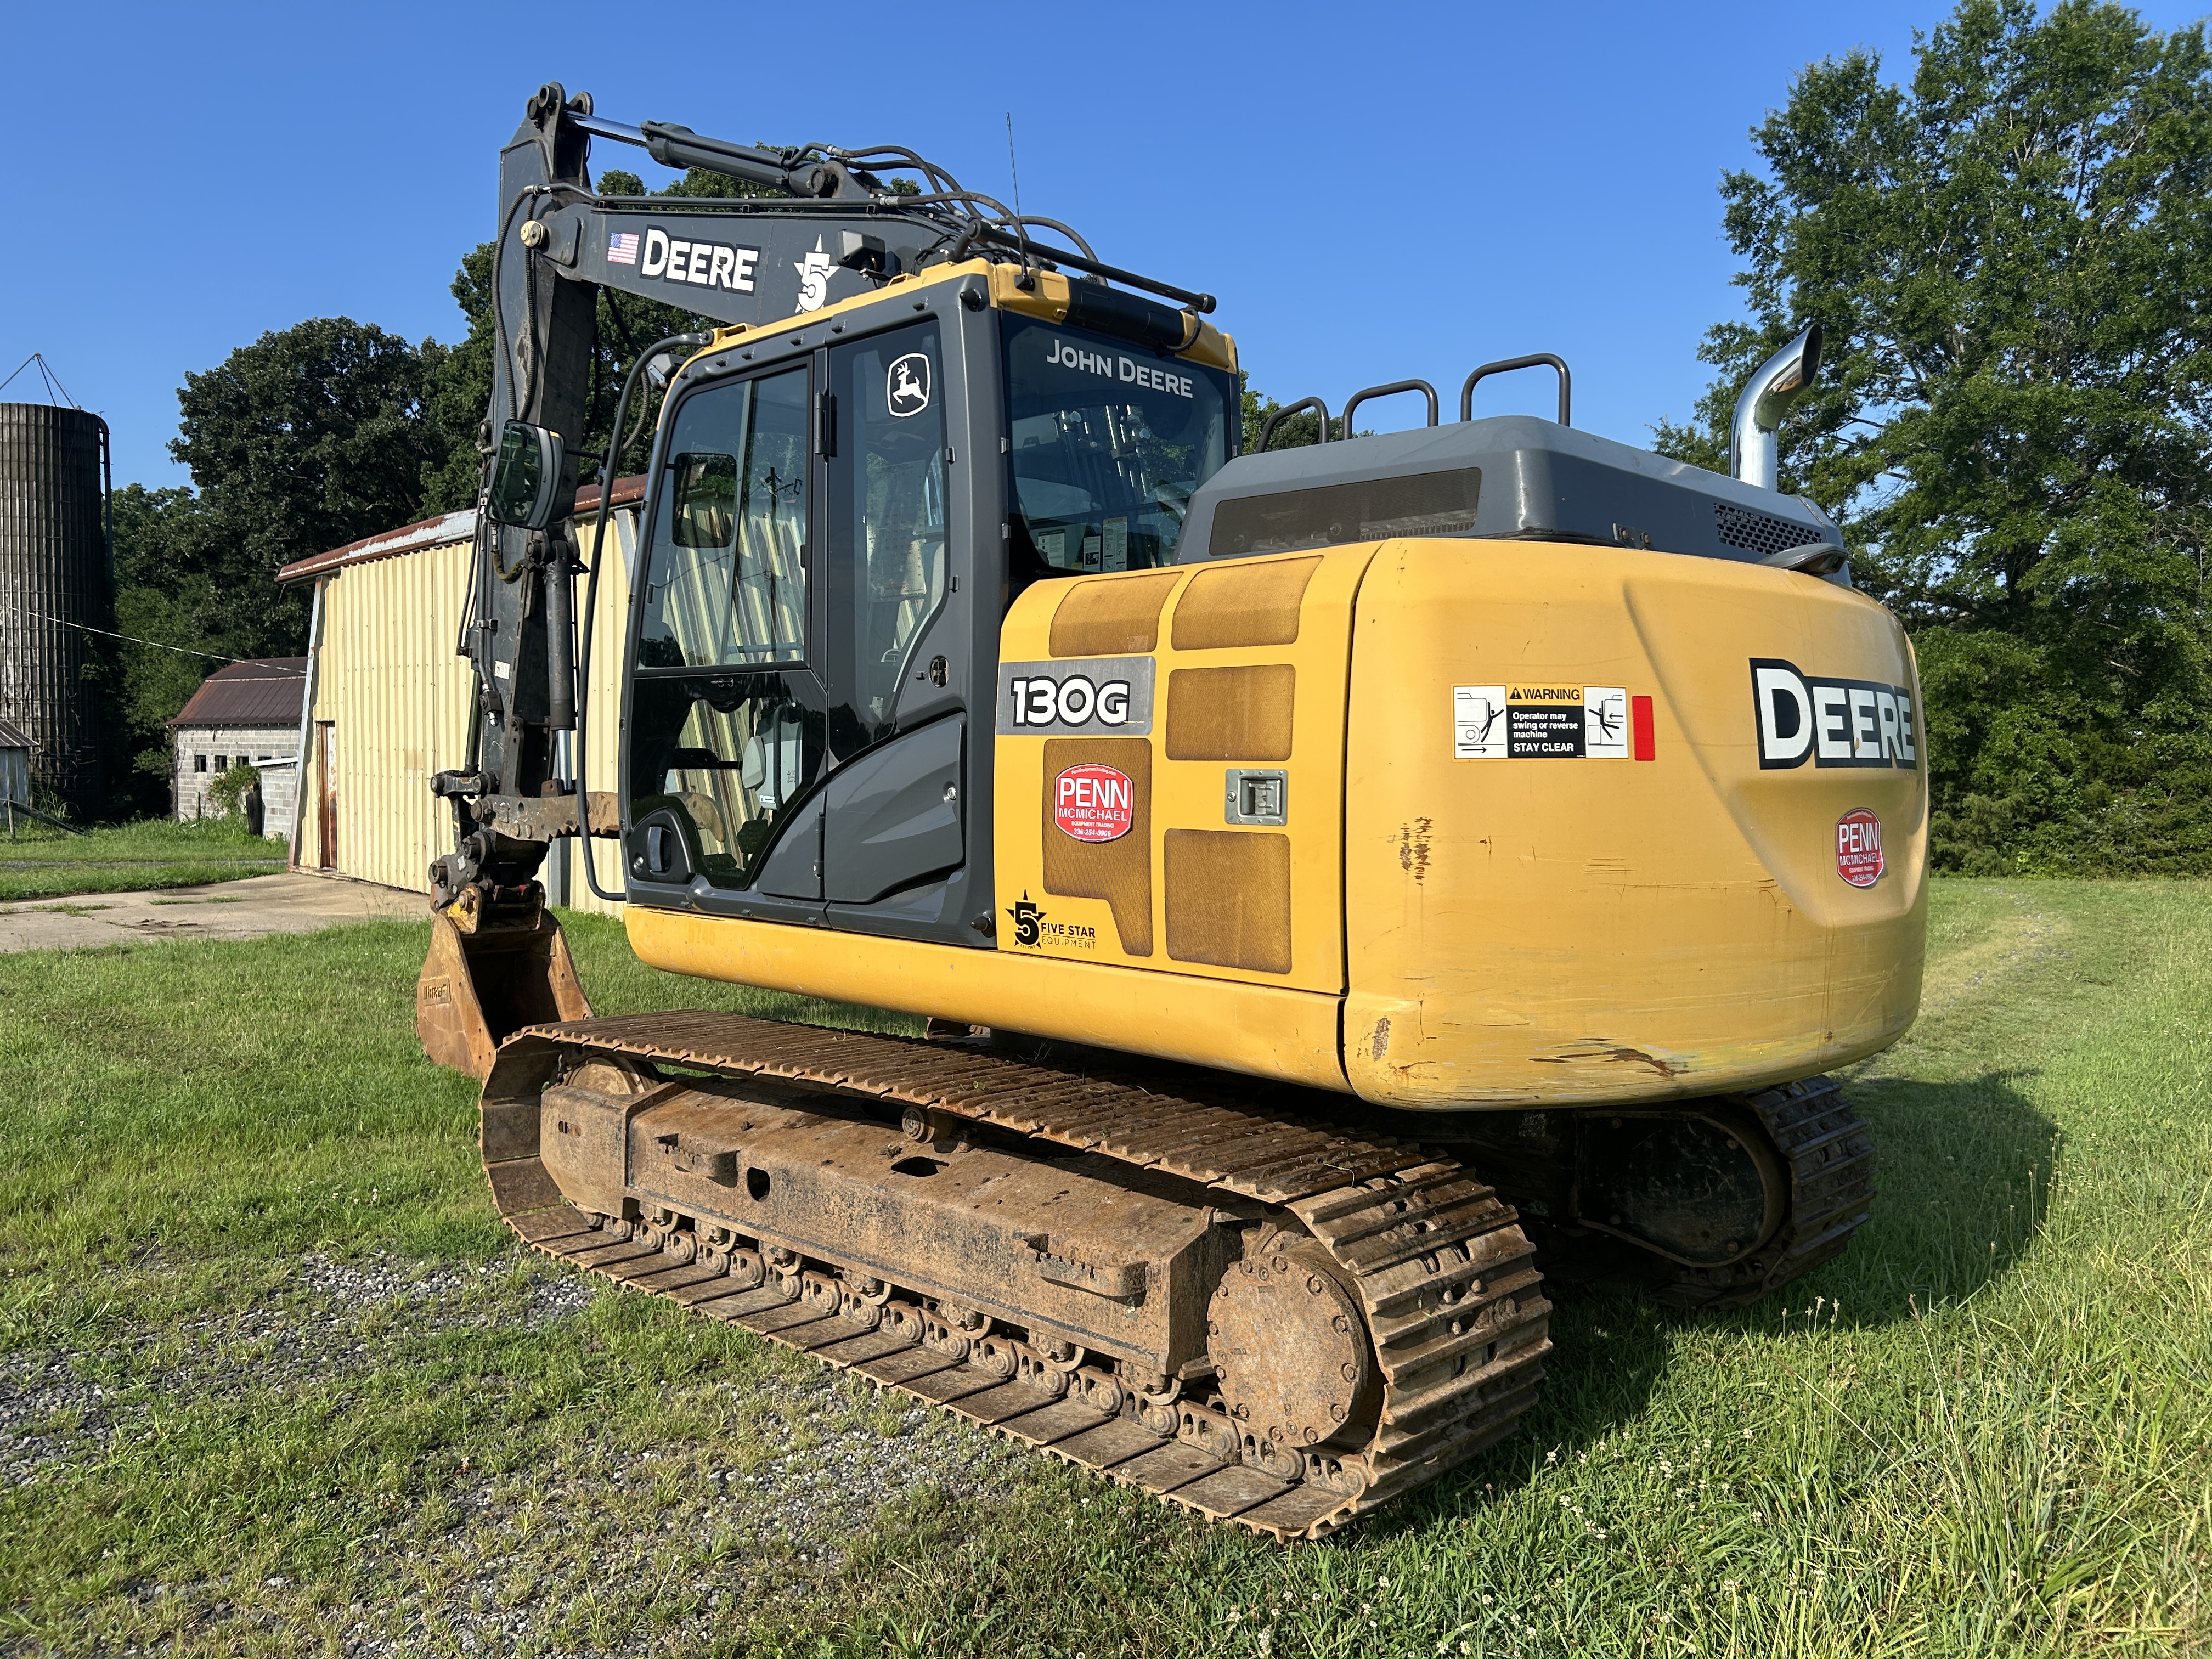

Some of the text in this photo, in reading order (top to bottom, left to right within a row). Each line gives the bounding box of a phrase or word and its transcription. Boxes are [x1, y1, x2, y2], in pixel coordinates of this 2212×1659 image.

[641, 228, 759, 292] DEERE
[797, 252, 830, 311] 5
[1047, 339, 1193, 398] JOHN DEERE
[1012, 675, 1130, 726] 130G
[1522, 688, 1580, 700] WARNING
[1513, 712, 1548, 721] Operator
[1756, 668, 1916, 761] DEERE
[1513, 721, 1537, 730] swing
[1513, 743, 1574, 752] STAY CLEAR
[1059, 777, 1128, 809] PENN
[1059, 807, 1128, 821] MCMICHAEL
[1073, 828, 1111, 837] 336-254-0906
[1839, 822, 1878, 854] PENN
[1839, 853, 1880, 866] MCMICHAEL
[1014, 901, 1040, 945] 5
[1041, 922, 1096, 938] FIVE STAR
[1041, 935, 1096, 949] EQUIPMENT
